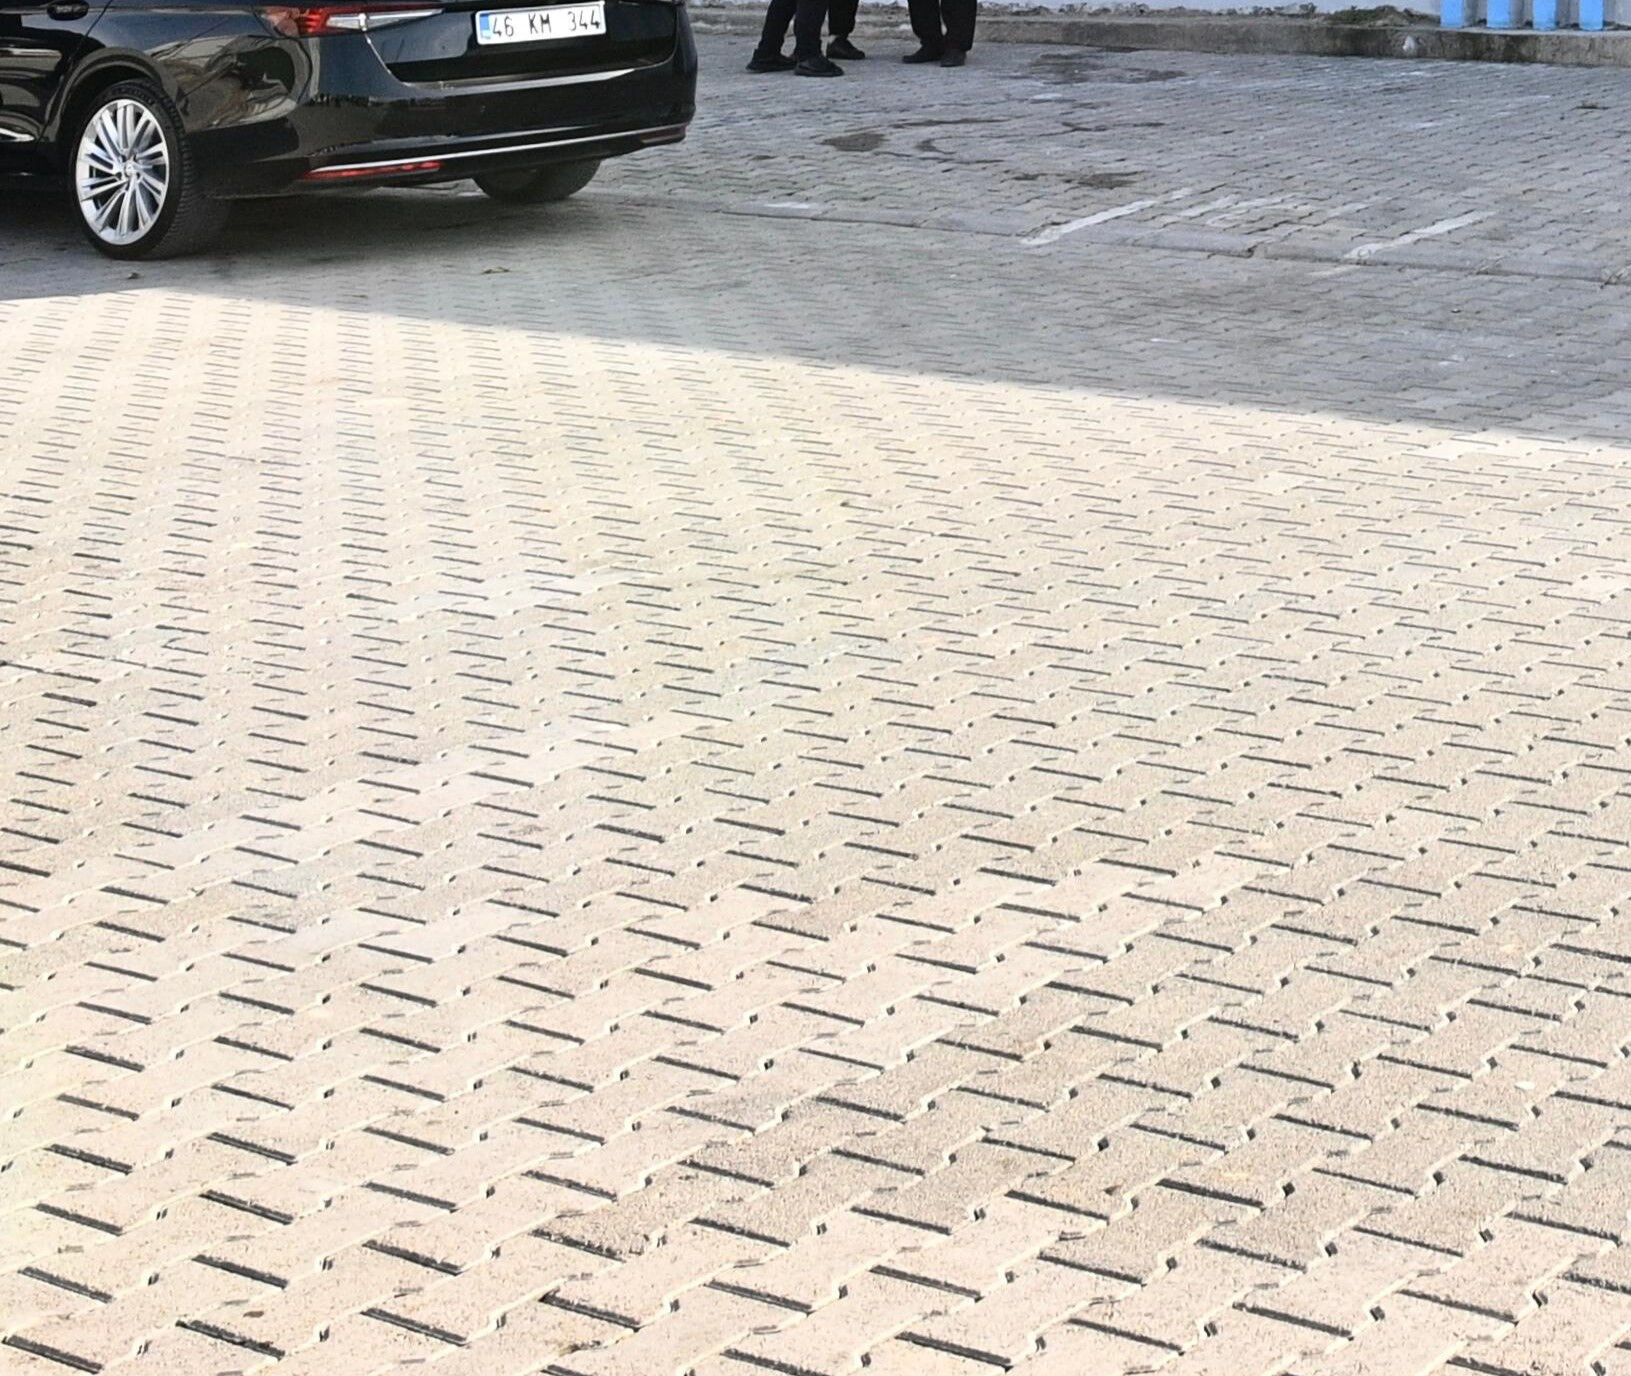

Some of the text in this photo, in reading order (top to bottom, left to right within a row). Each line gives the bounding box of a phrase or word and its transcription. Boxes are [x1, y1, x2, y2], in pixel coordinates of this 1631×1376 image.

[492, 9, 601, 38] 46 KM 344
